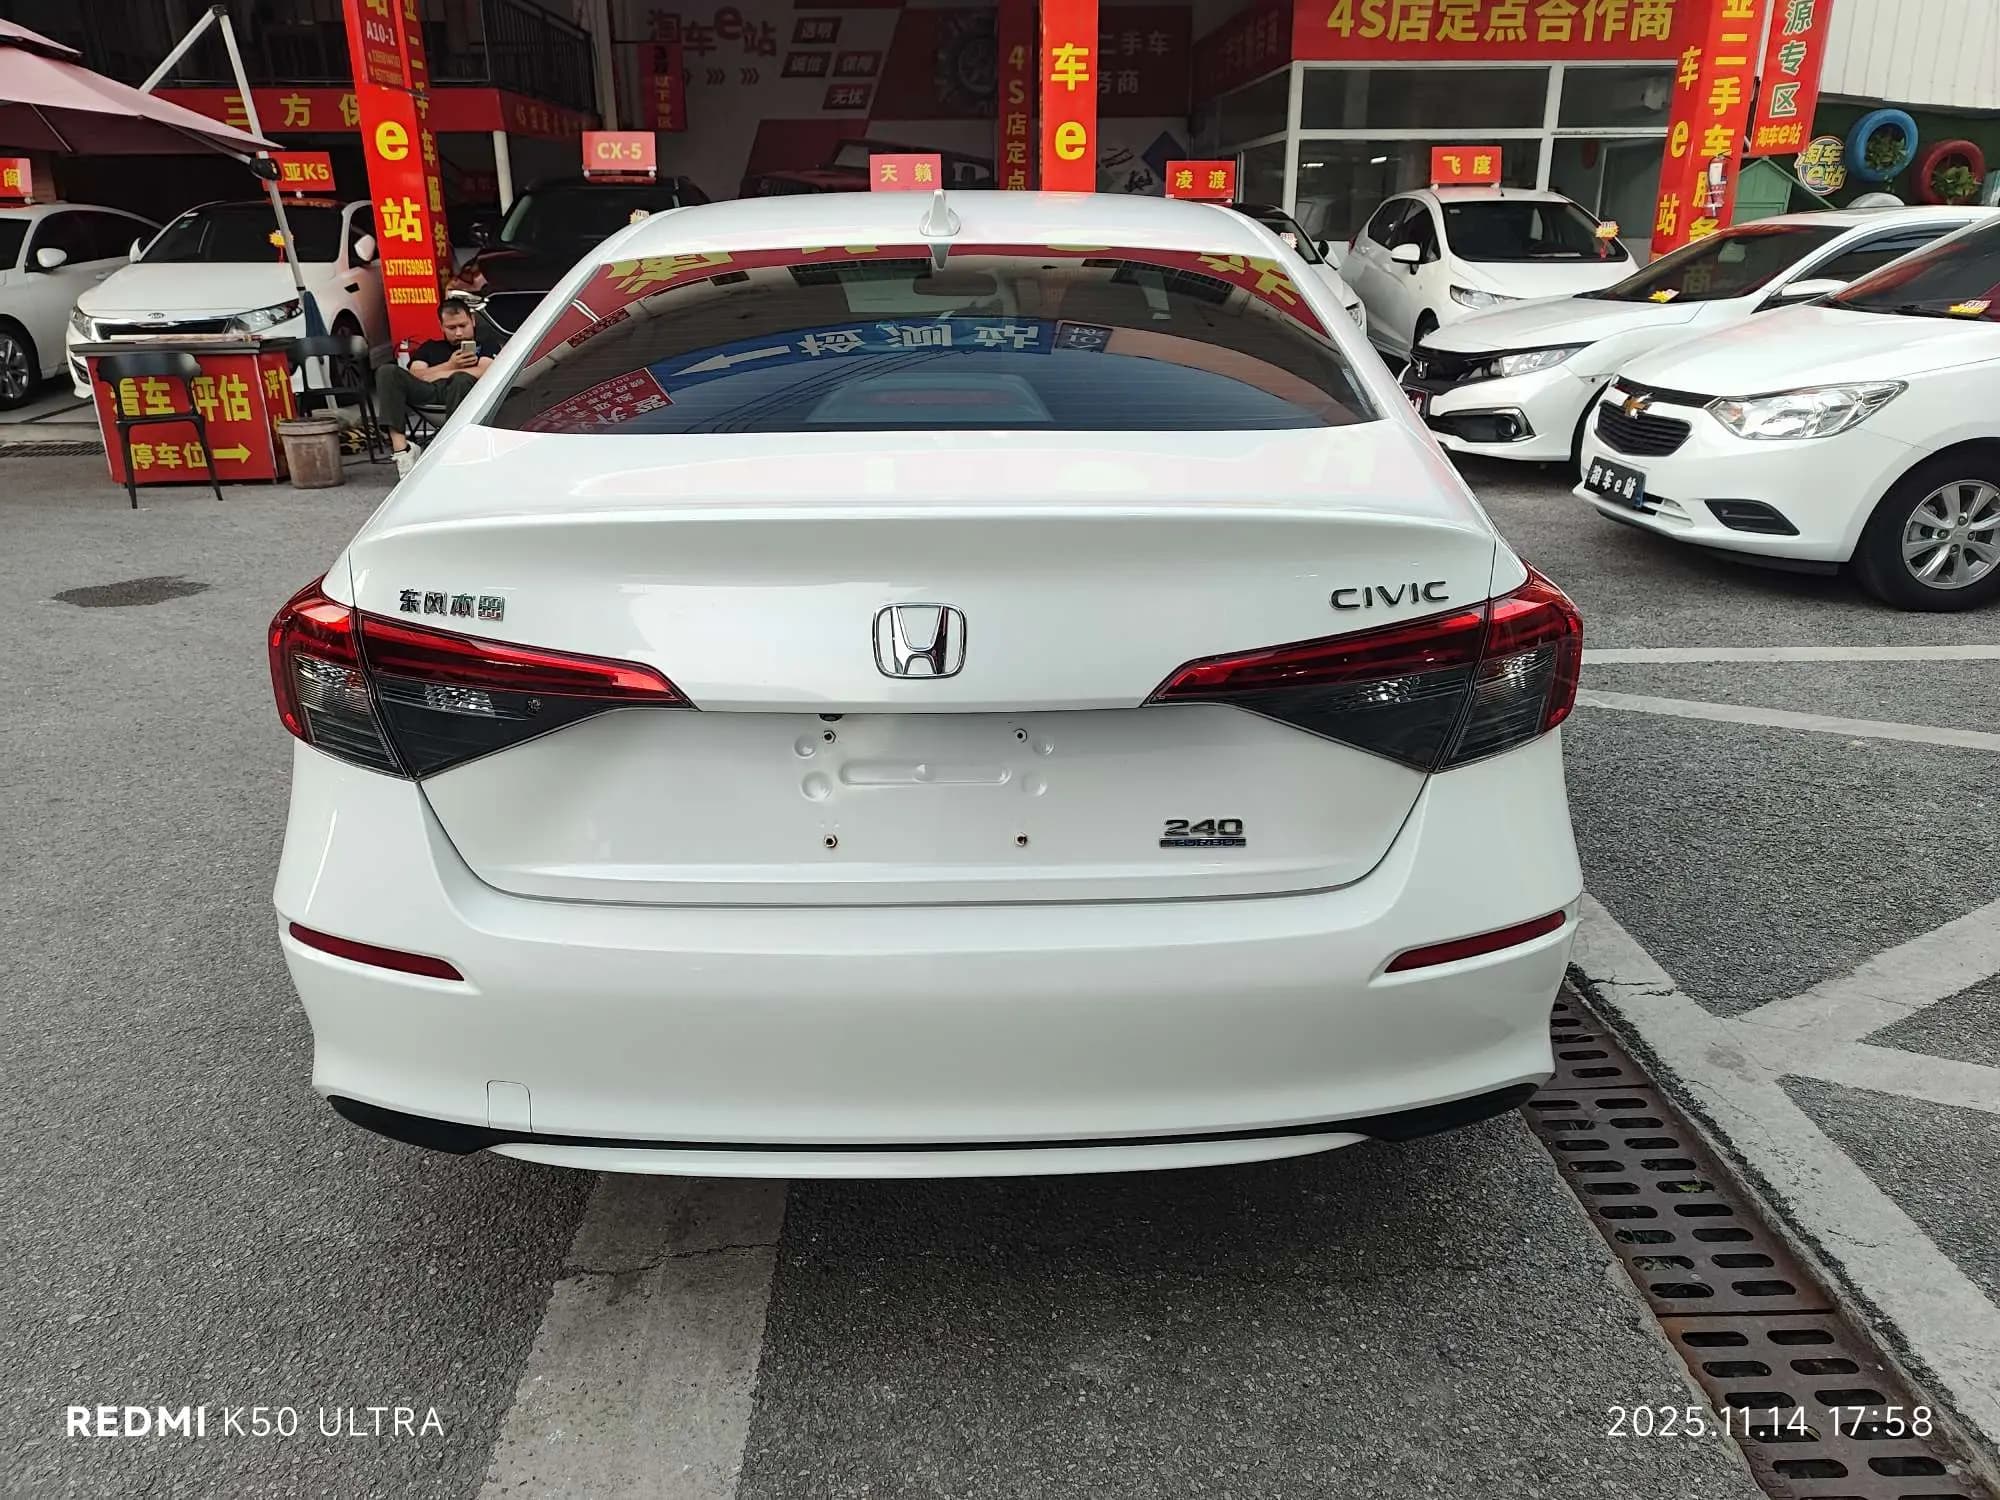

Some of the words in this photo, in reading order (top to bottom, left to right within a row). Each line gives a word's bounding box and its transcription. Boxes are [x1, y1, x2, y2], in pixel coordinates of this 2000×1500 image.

[366, 20, 396, 46] A10-1
[1327, 0, 1674, 42] 4S店定点合作商
[1769, 0, 1815, 119] 源专区
[1006, 45, 1028, 191] 4S店定点
[597, 142, 642, 160] CX-5
[1656, 46, 1702, 236] 车e站
[271, 162, 330, 182] 亚K5
[880, 163, 934, 184] 天籁
[1442, 154, 1492, 175] 飞度
[1175, 170, 1227, 190] 凌渡
[110, 376, 176, 417] 看车
[192, 374, 252, 421] 评估
[130, 442, 208, 470] 停车位
[1589, 464, 1637, 499] 淘车e站
[1329, 580, 1450, 611] CIVIC
[1164, 818, 1244, 836] 240
